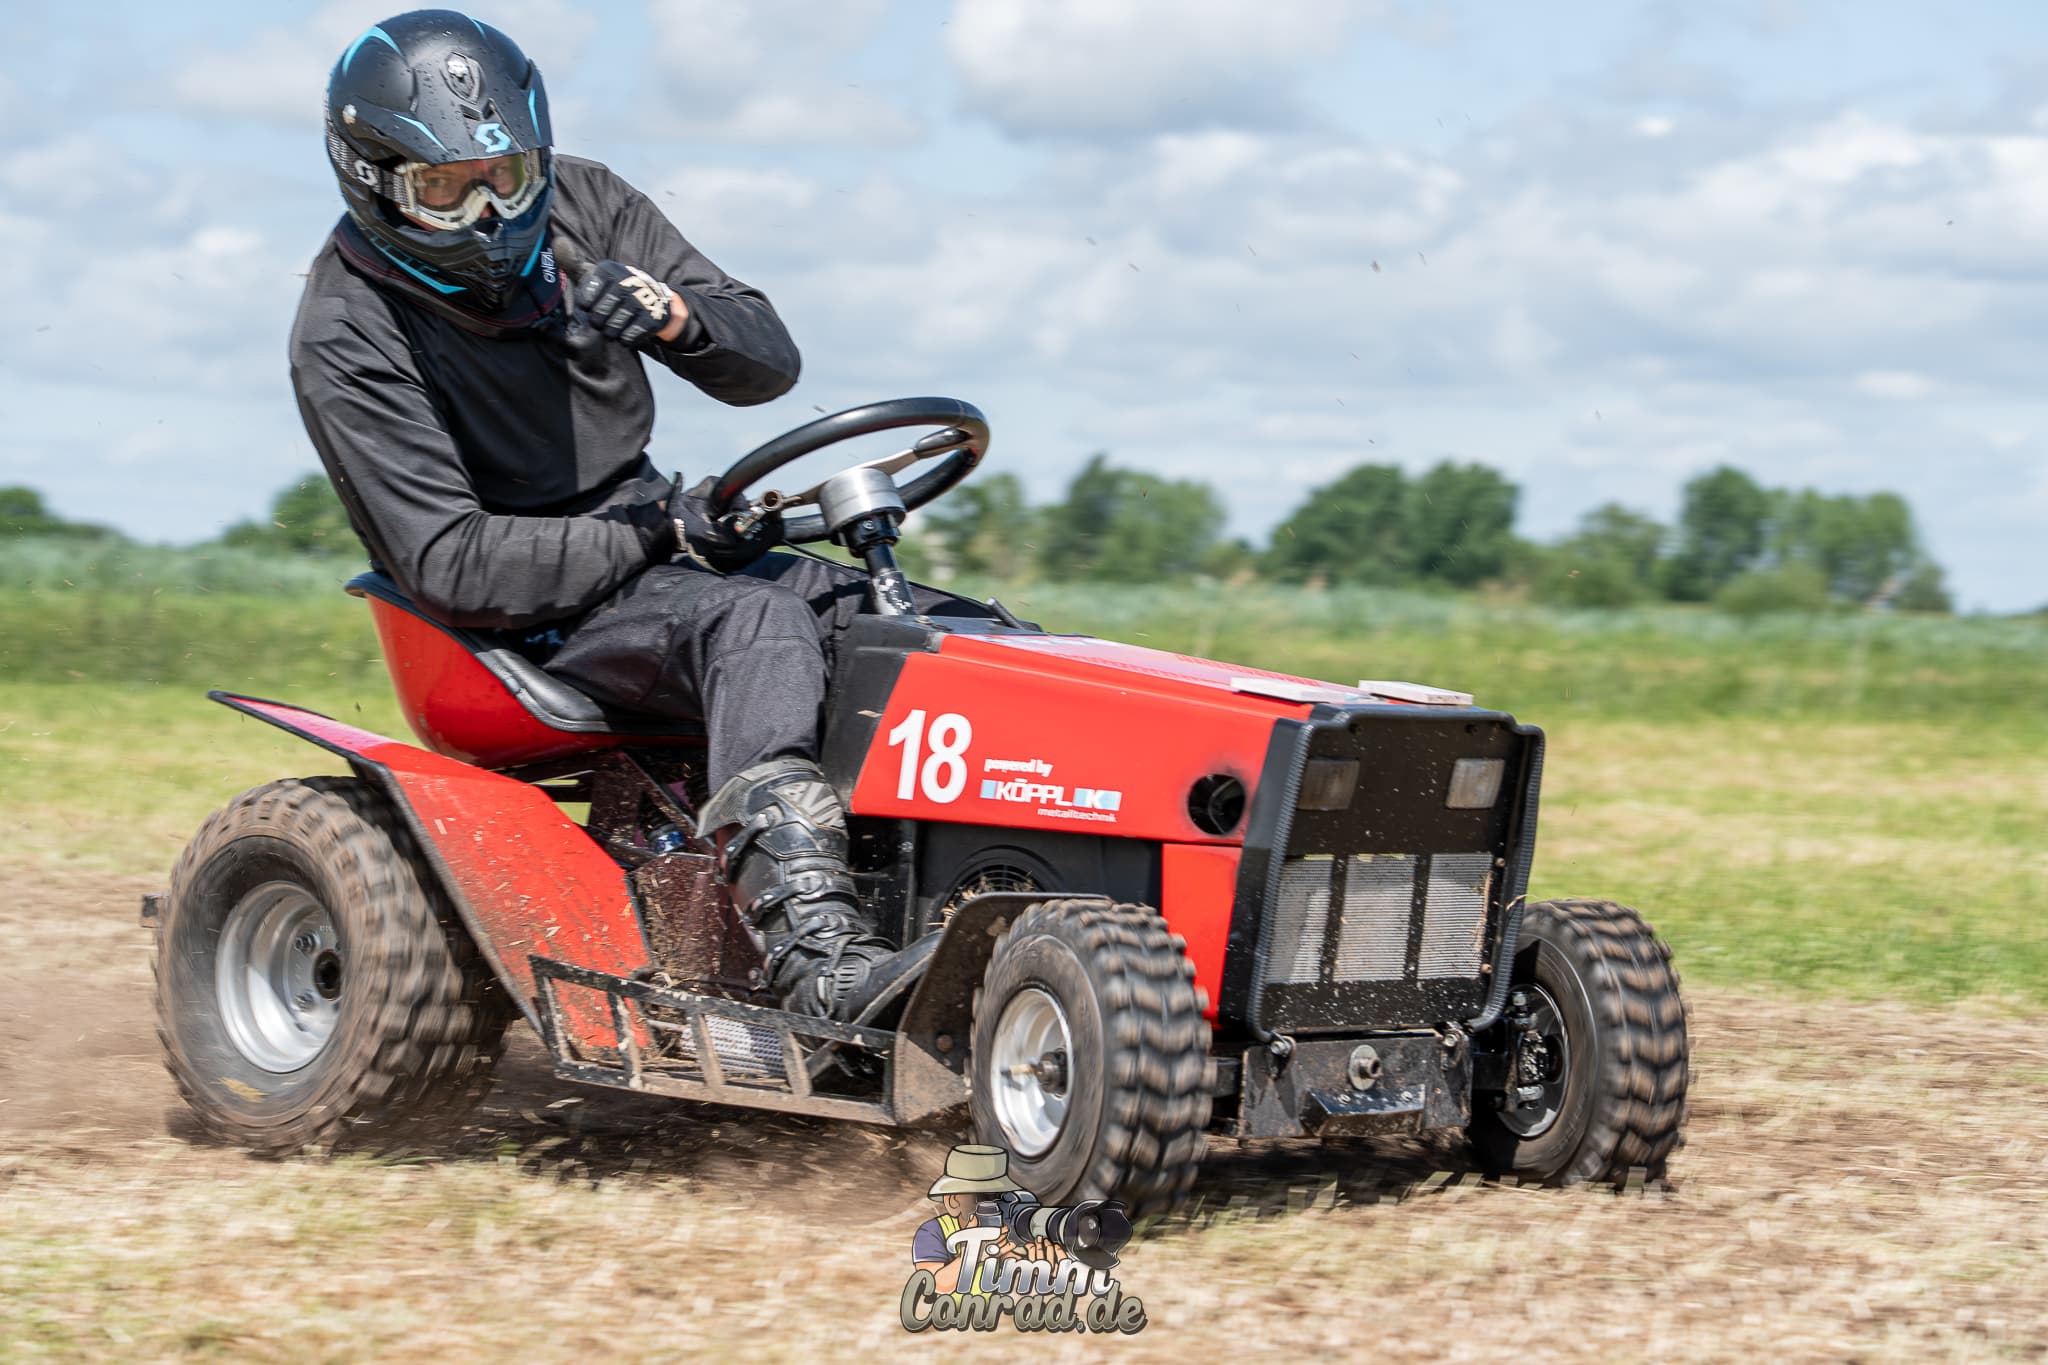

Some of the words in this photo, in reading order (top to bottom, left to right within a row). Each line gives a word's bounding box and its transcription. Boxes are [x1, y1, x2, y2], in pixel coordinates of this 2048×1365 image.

[888, 709, 972, 804] 18
[984, 758, 1036, 773] powered
[1036, 759, 1053, 777] by
